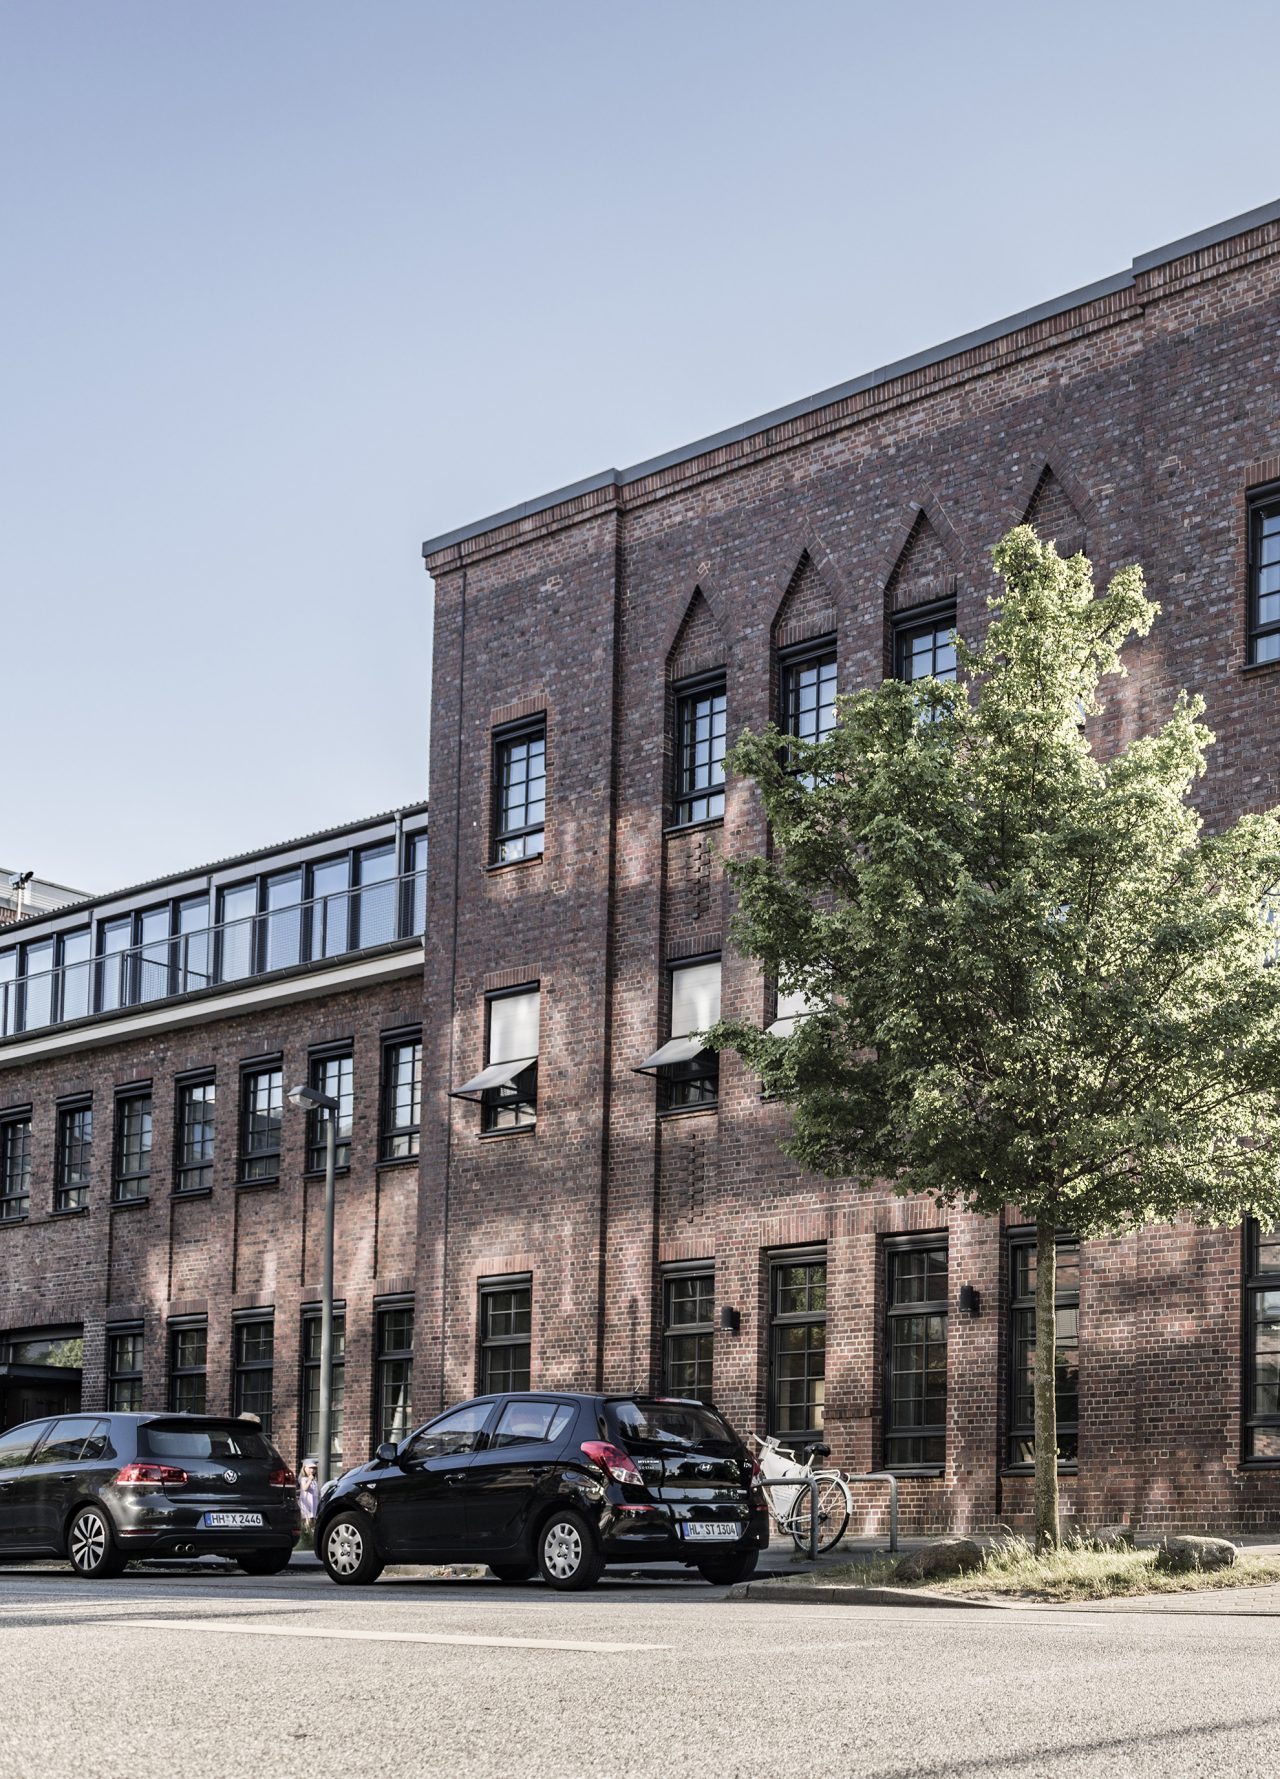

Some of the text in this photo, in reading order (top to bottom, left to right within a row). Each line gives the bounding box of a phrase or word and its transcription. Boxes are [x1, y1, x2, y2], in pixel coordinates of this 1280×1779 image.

[212, 1514, 262, 1524] HH X 2446
[689, 1523, 736, 1535] HL ST 1304
